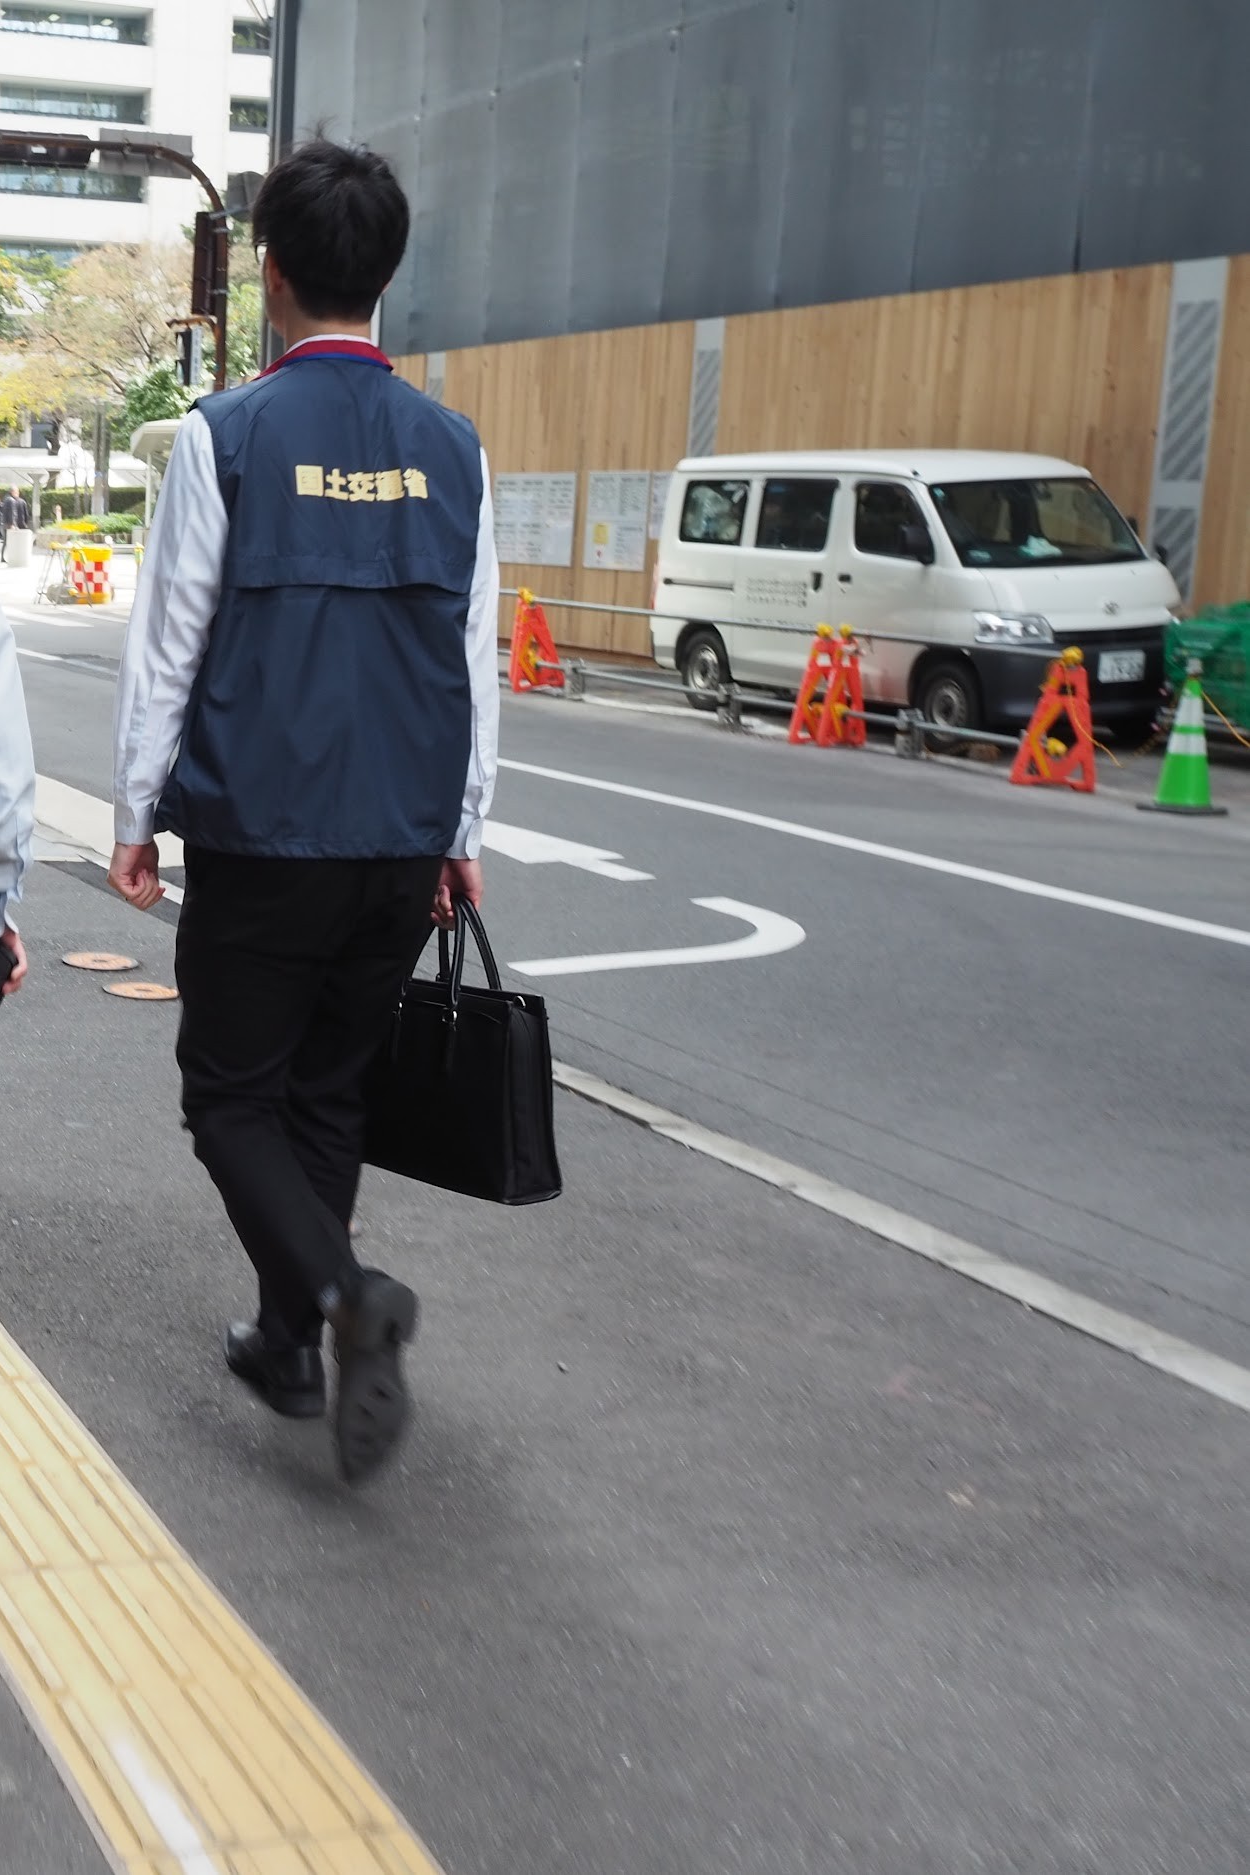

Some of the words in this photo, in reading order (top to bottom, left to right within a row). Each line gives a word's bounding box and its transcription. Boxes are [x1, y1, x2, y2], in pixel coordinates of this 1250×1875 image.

[295, 464, 428, 502] 国土交通省
